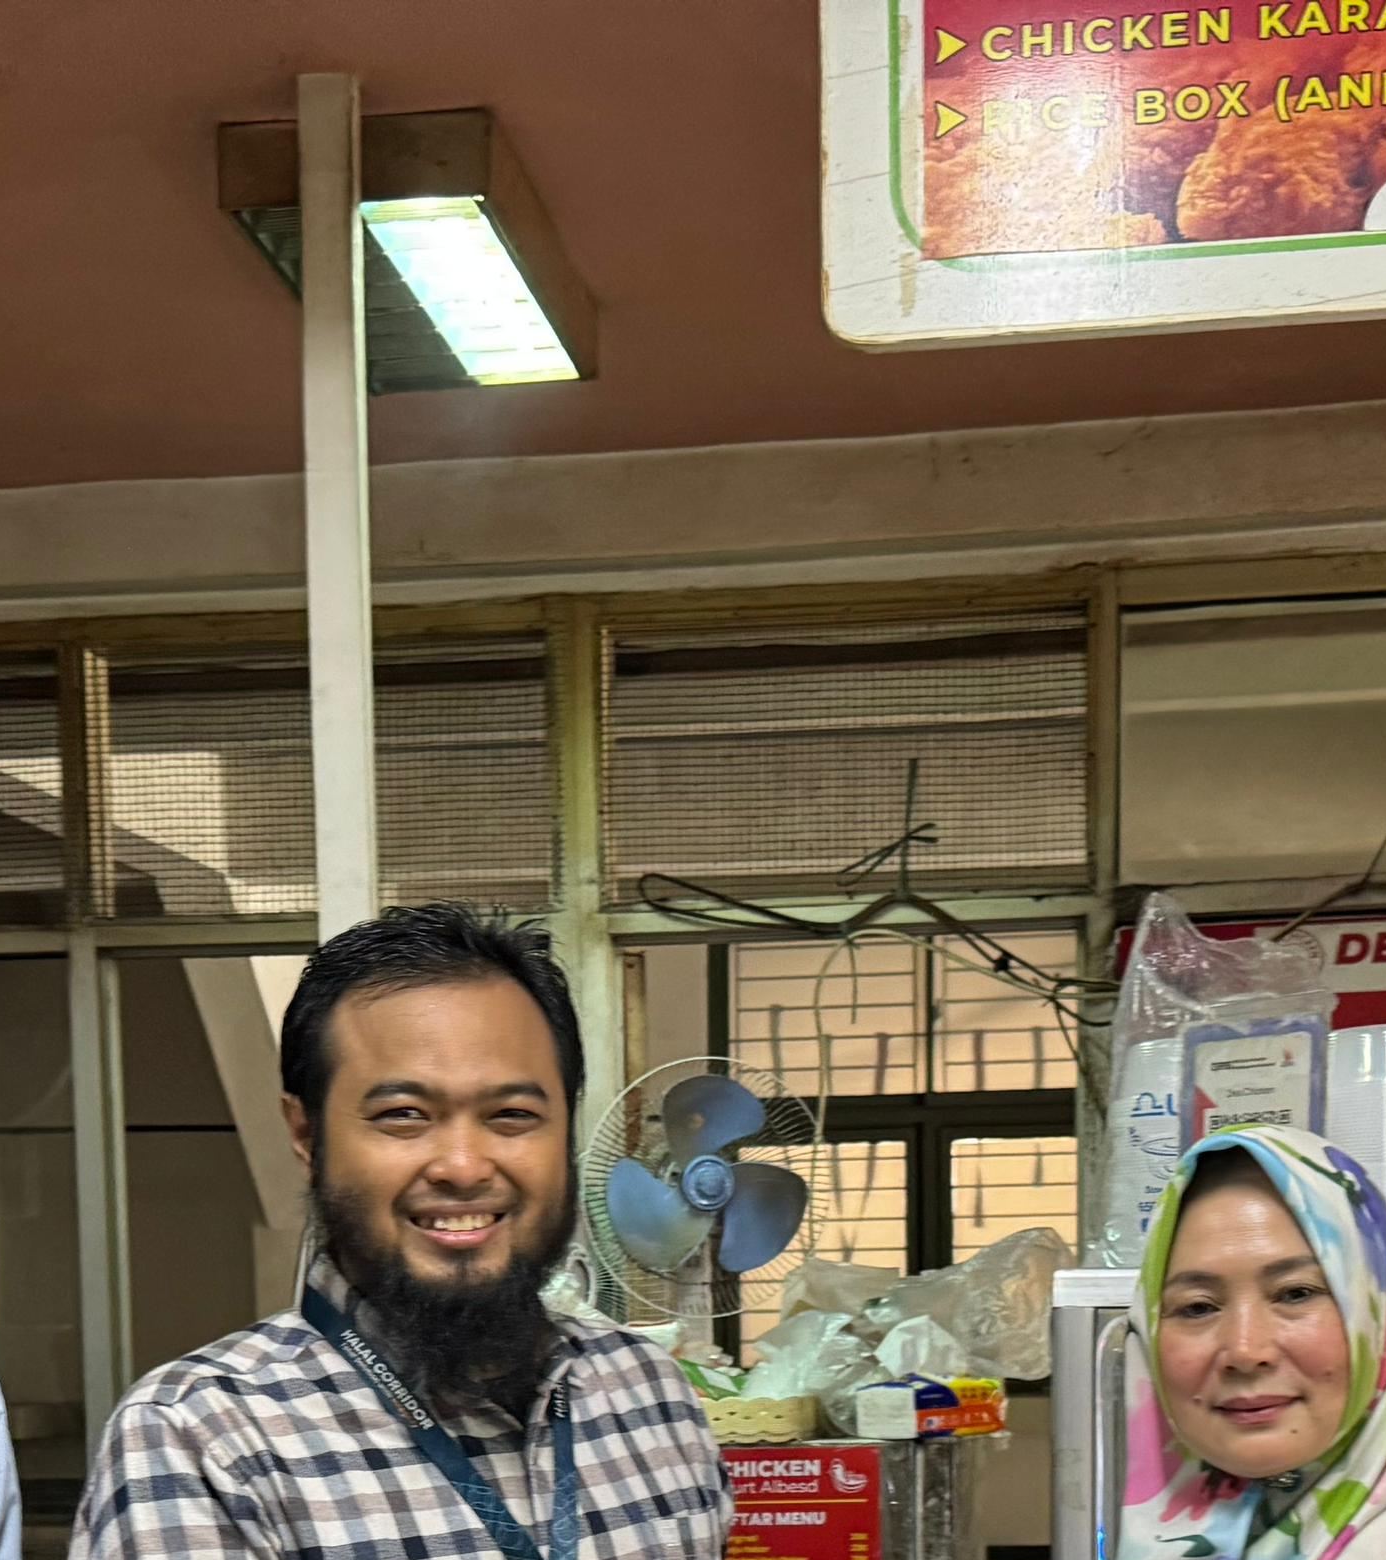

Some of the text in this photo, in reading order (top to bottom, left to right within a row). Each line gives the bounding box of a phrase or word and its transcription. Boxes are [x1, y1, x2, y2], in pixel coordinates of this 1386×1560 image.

[980, 7, 1231, 62] CHICKEN
[1134, 82, 1250, 124] BOX
[340, 1329, 376, 1367] HALAL
[372, 1361, 436, 1431] CORRIDOR
[775, 1511, 827, 1526] MENU
